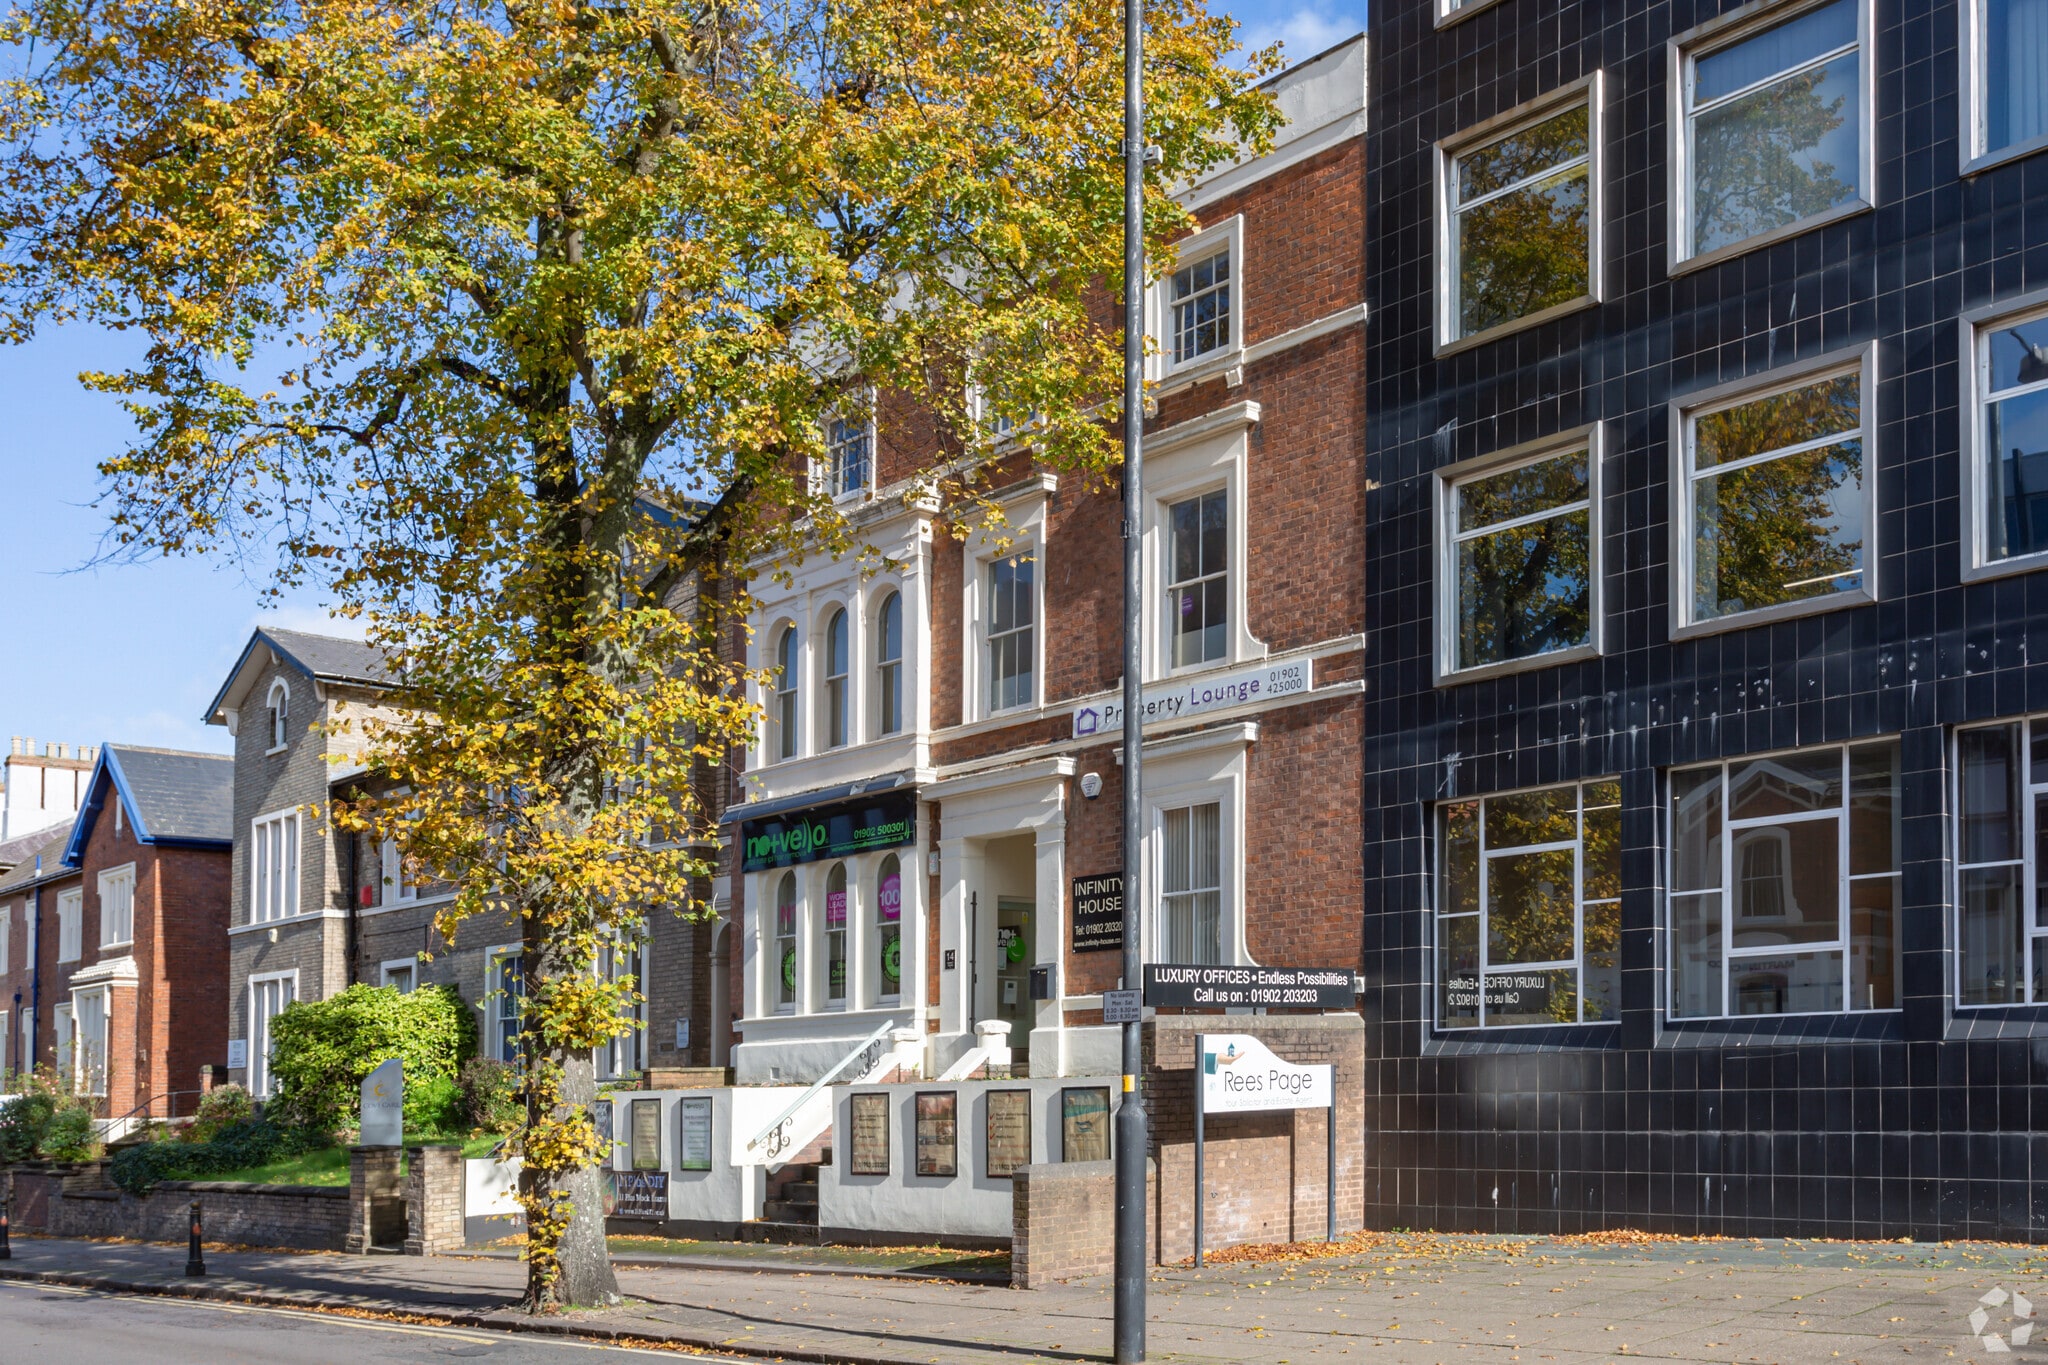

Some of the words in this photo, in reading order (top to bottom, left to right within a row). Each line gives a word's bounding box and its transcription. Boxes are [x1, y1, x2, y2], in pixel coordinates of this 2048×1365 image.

[1270, 667, 1299, 682] 01902
[1267, 678, 1304, 694] 425000
[1105, 696, 1184, 723] Prerty
[1191, 679, 1260, 705] Lounge
[853, 827, 876, 839] 01902
[877, 821, 904, 835] 500301
[1075, 877, 1124, 896] INFINITY
[1078, 896, 1122, 915] HOUSE
[1086, 922, 1103, 935] 01902
[1104, 921, 1123, 933] 20320
[946, 951, 955, 961] 14
[1155, 968, 1201, 983] LUXURY
[1203, 969, 1250, 984] OFFICES
[1258, 971, 1295, 985] Endless
[1297, 971, 1348, 986] Possibilities
[1194, 988, 1214, 1002] Call
[1216, 991, 1228, 1002] us
[1230, 991, 1242, 1002] on
[1251, 989, 1281, 1002] 01902
[1283, 989, 1317, 1003] 203203
[1224, 1071, 1263, 1092] Rees
[1269, 1069, 1312, 1095] Page
